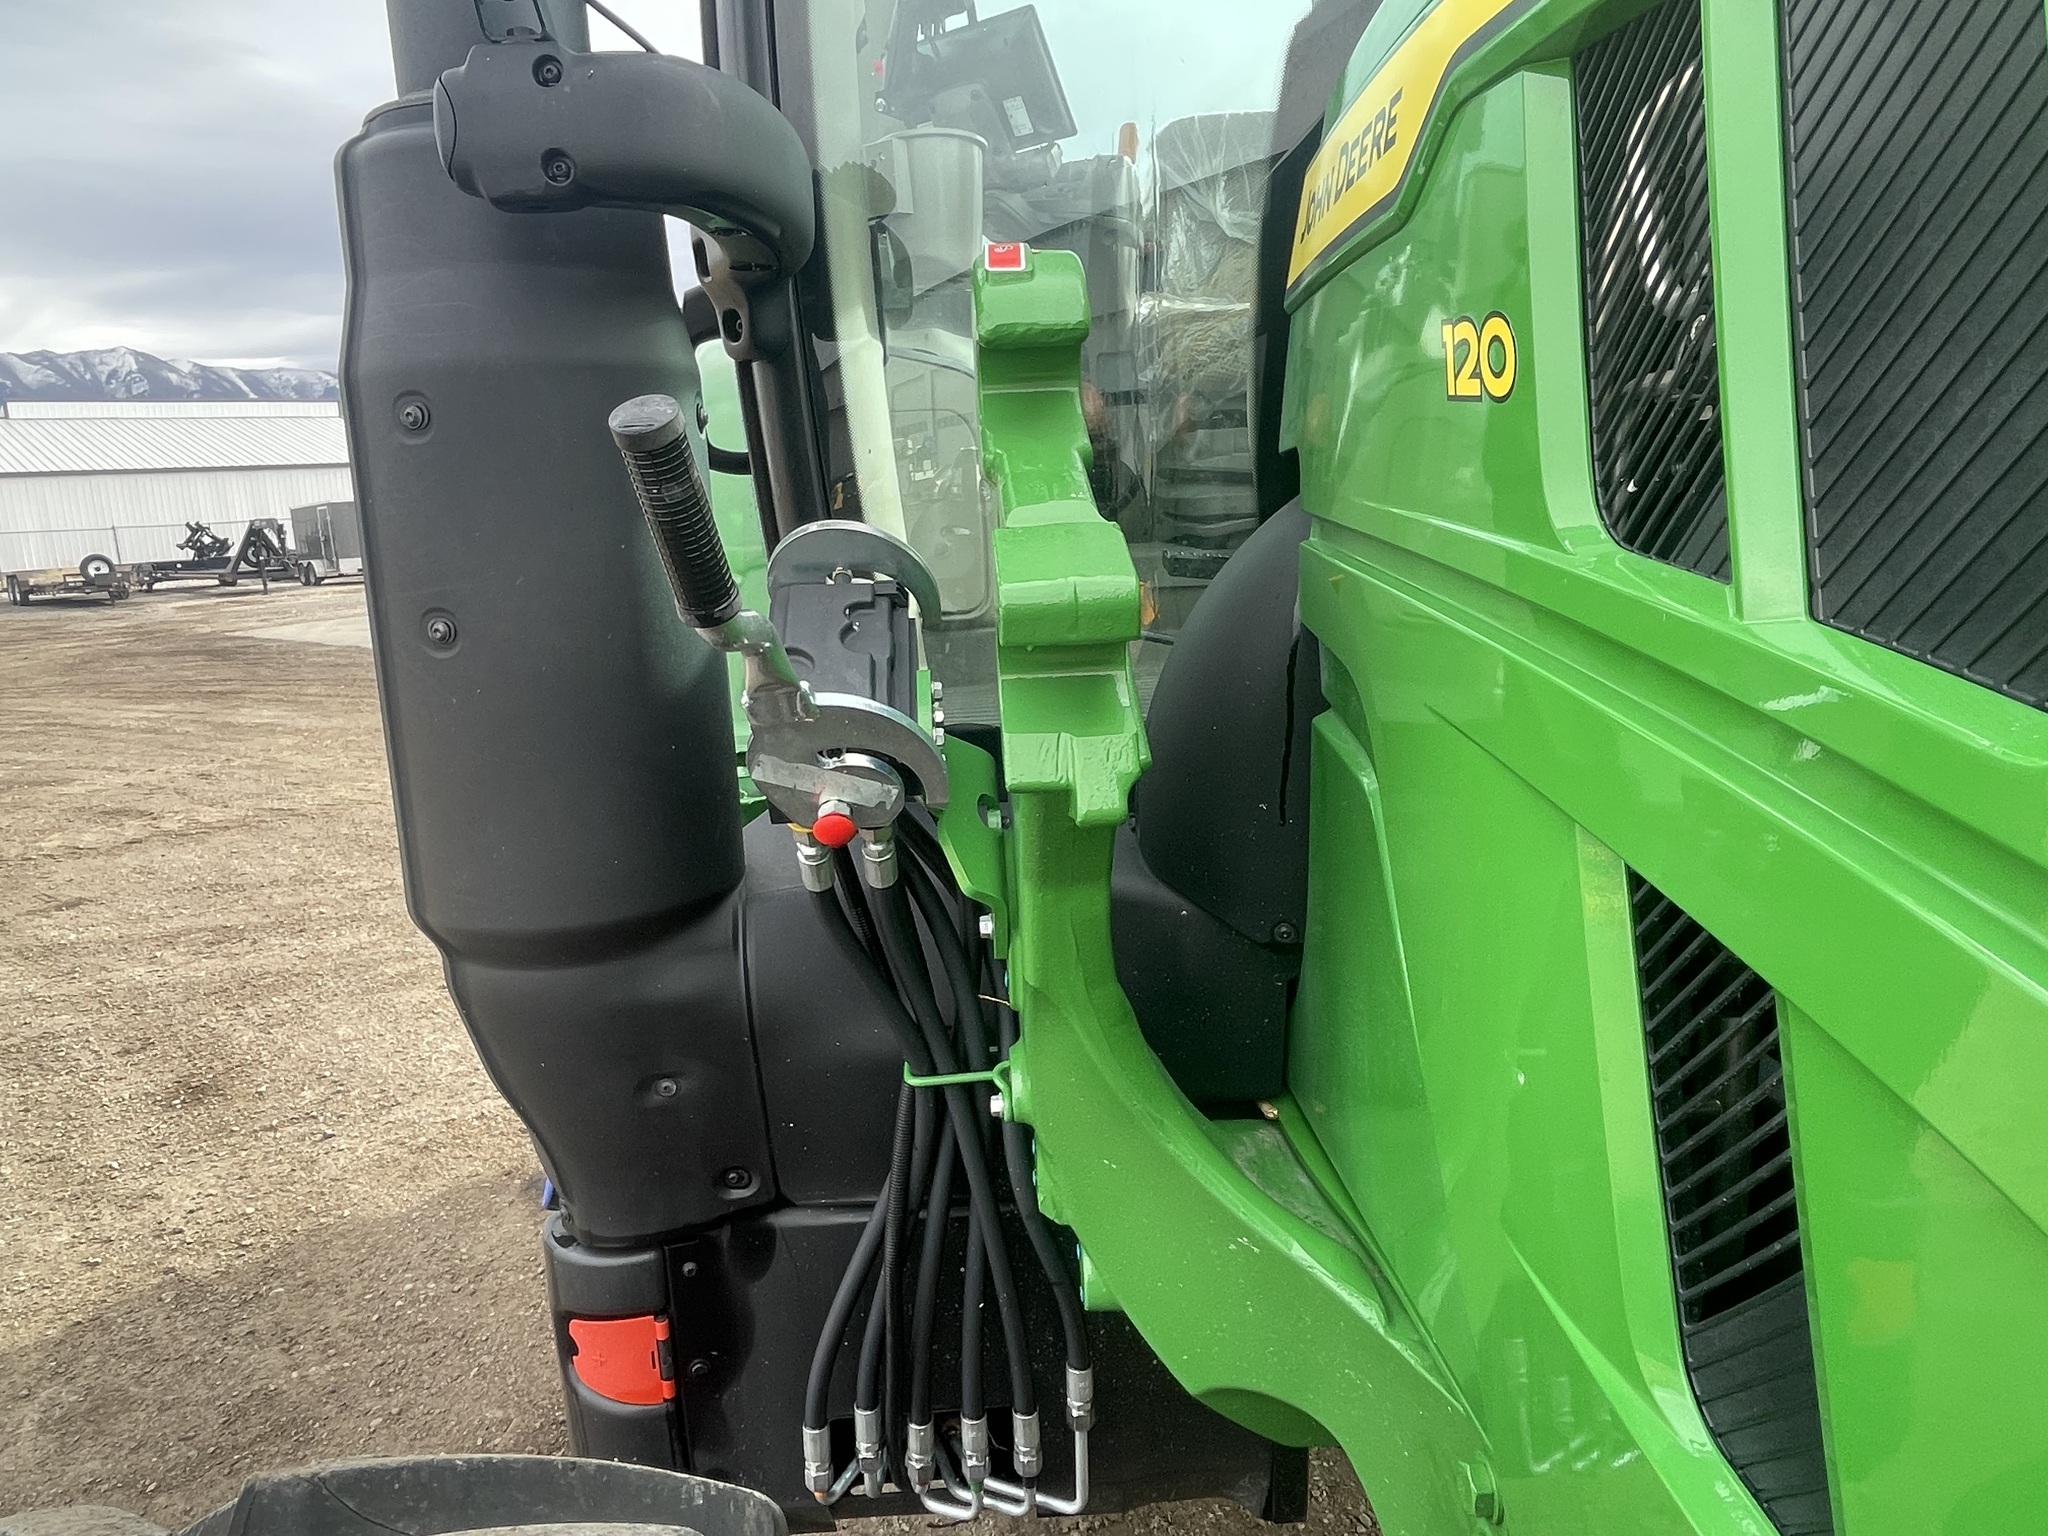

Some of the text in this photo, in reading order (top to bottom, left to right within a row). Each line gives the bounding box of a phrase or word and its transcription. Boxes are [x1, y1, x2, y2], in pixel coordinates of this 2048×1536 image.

[1300, 87, 1404, 244] JOHN DEERE
[1441, 310, 1517, 404] 120
